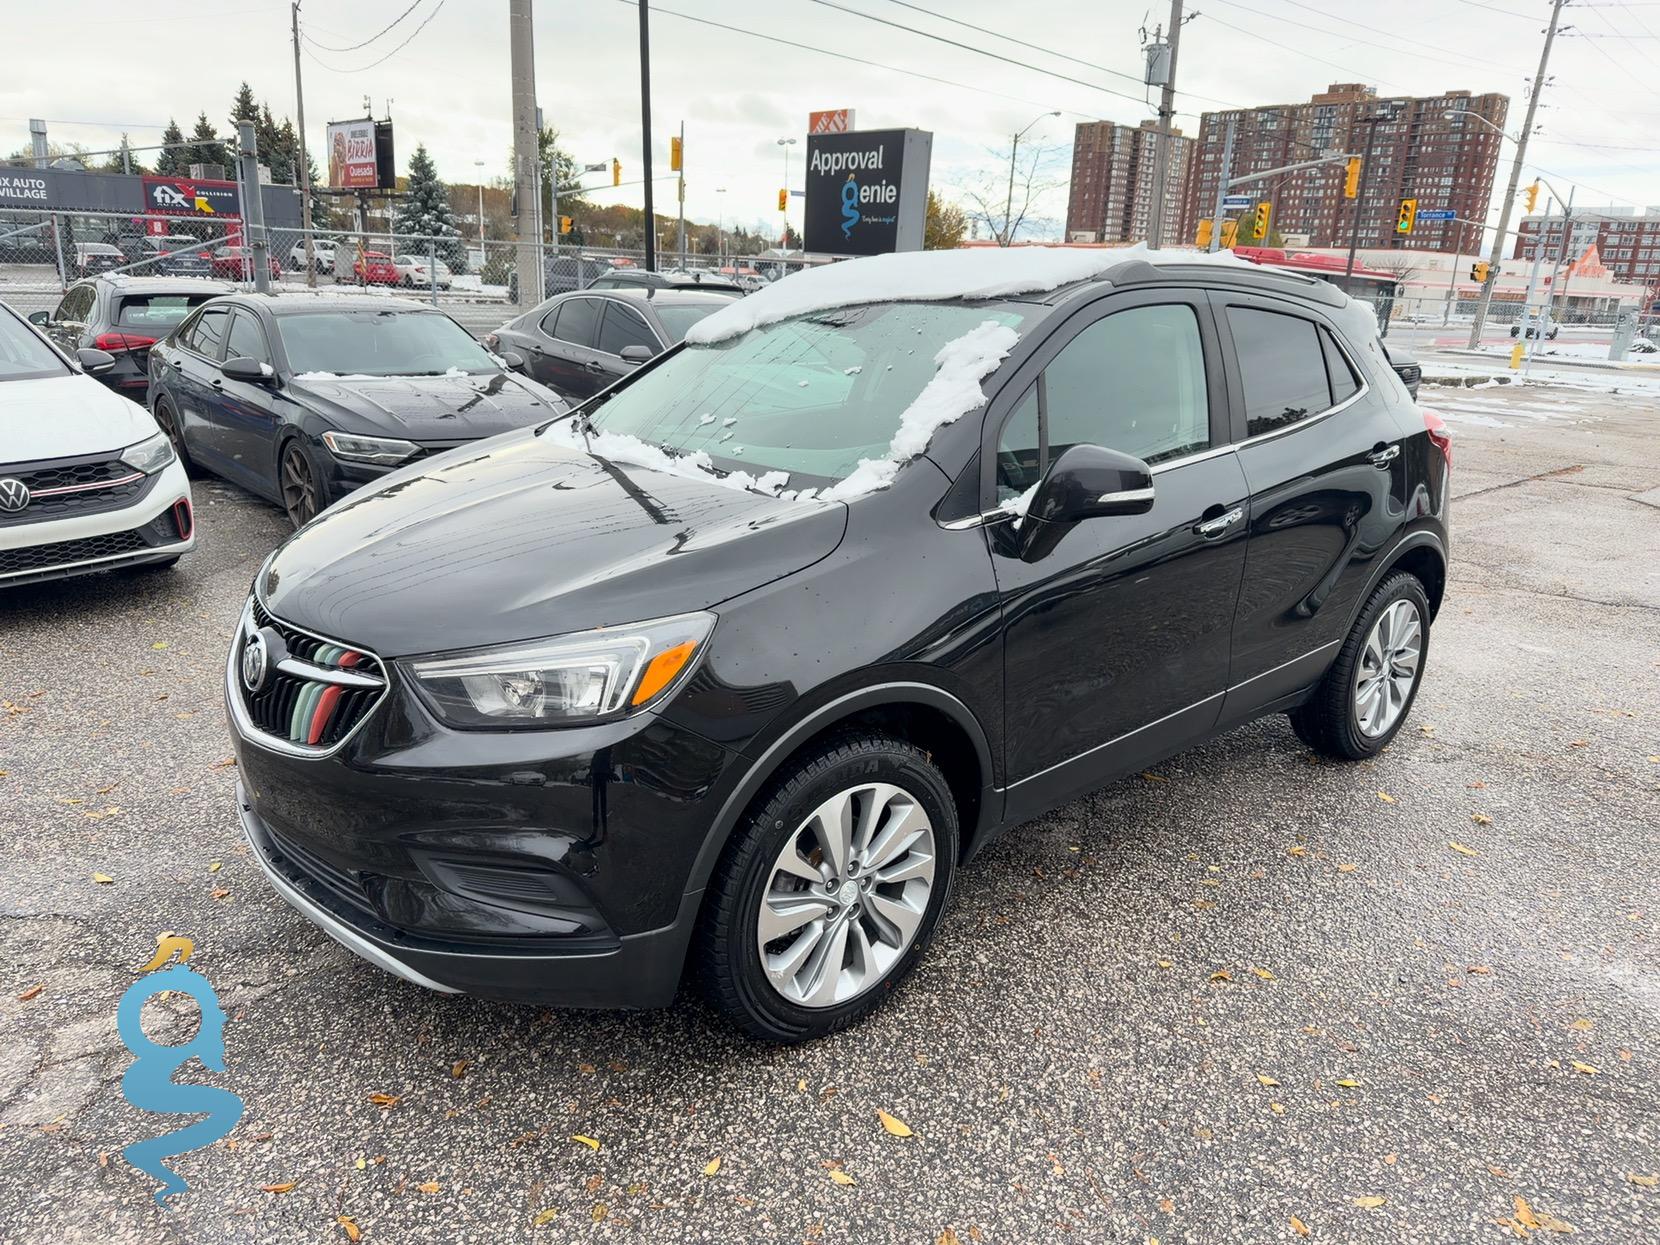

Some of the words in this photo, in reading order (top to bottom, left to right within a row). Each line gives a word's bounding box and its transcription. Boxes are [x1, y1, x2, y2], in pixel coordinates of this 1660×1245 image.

[810, 144, 884, 176] Approval
[350, 165, 373, 177] Quesada
[12, 178, 46, 189] AUTO
[0, 187, 47, 199] VILLAGE
